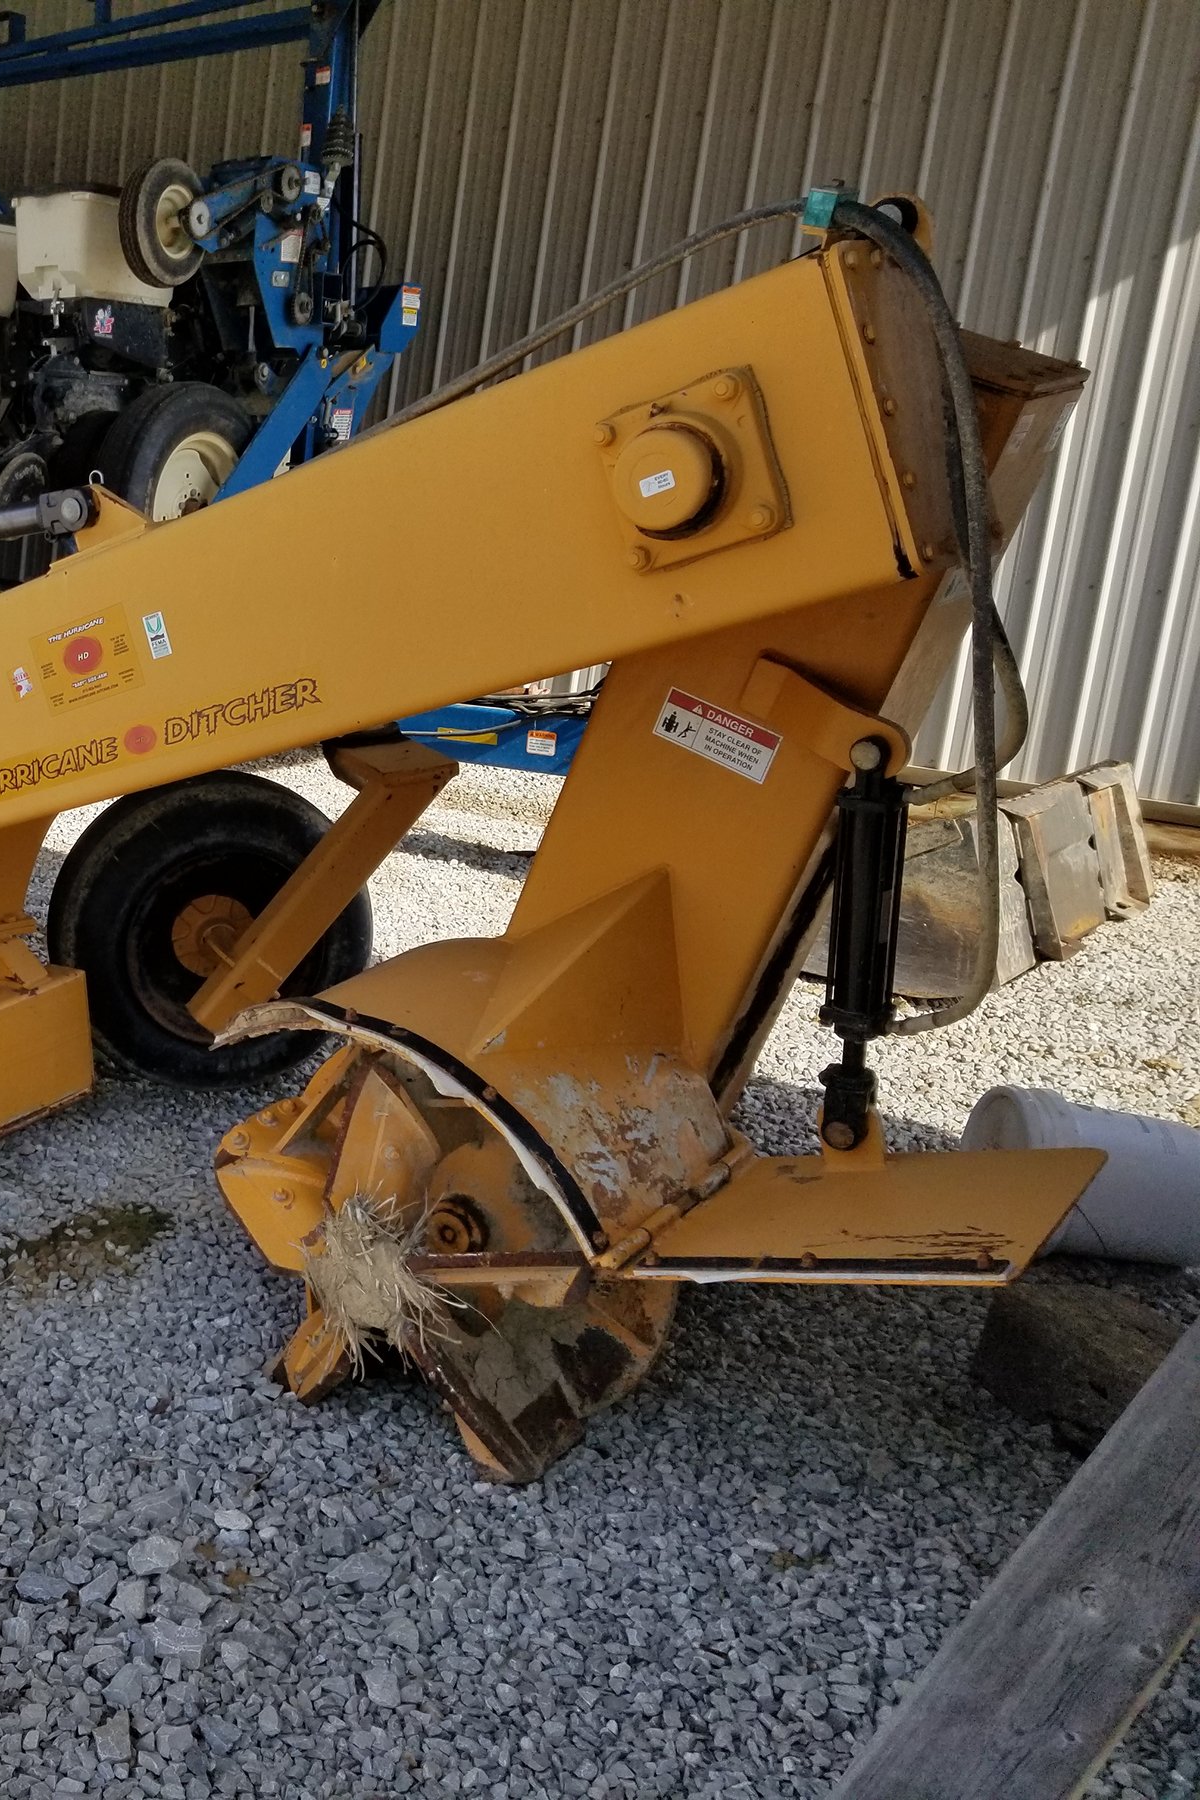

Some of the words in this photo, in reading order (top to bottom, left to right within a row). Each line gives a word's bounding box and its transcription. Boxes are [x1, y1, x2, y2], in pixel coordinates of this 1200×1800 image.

[48, 634, 62, 644] THE
[63, 617, 104, 638] HURRICANE
[77, 651, 89, 661] HD
[164, 678, 322, 745] DITCHER
[706, 709, 754, 738] DANGER
[704, 735, 737, 754] MACHINE
[737, 750, 760, 765] WHEN
[708, 727, 727, 740] STAY
[727, 736, 750, 751] CLEAR
[752, 747, 762, 756] OF
[704, 744, 712, 752] IN
[713, 748, 753, 771] OPERATION
